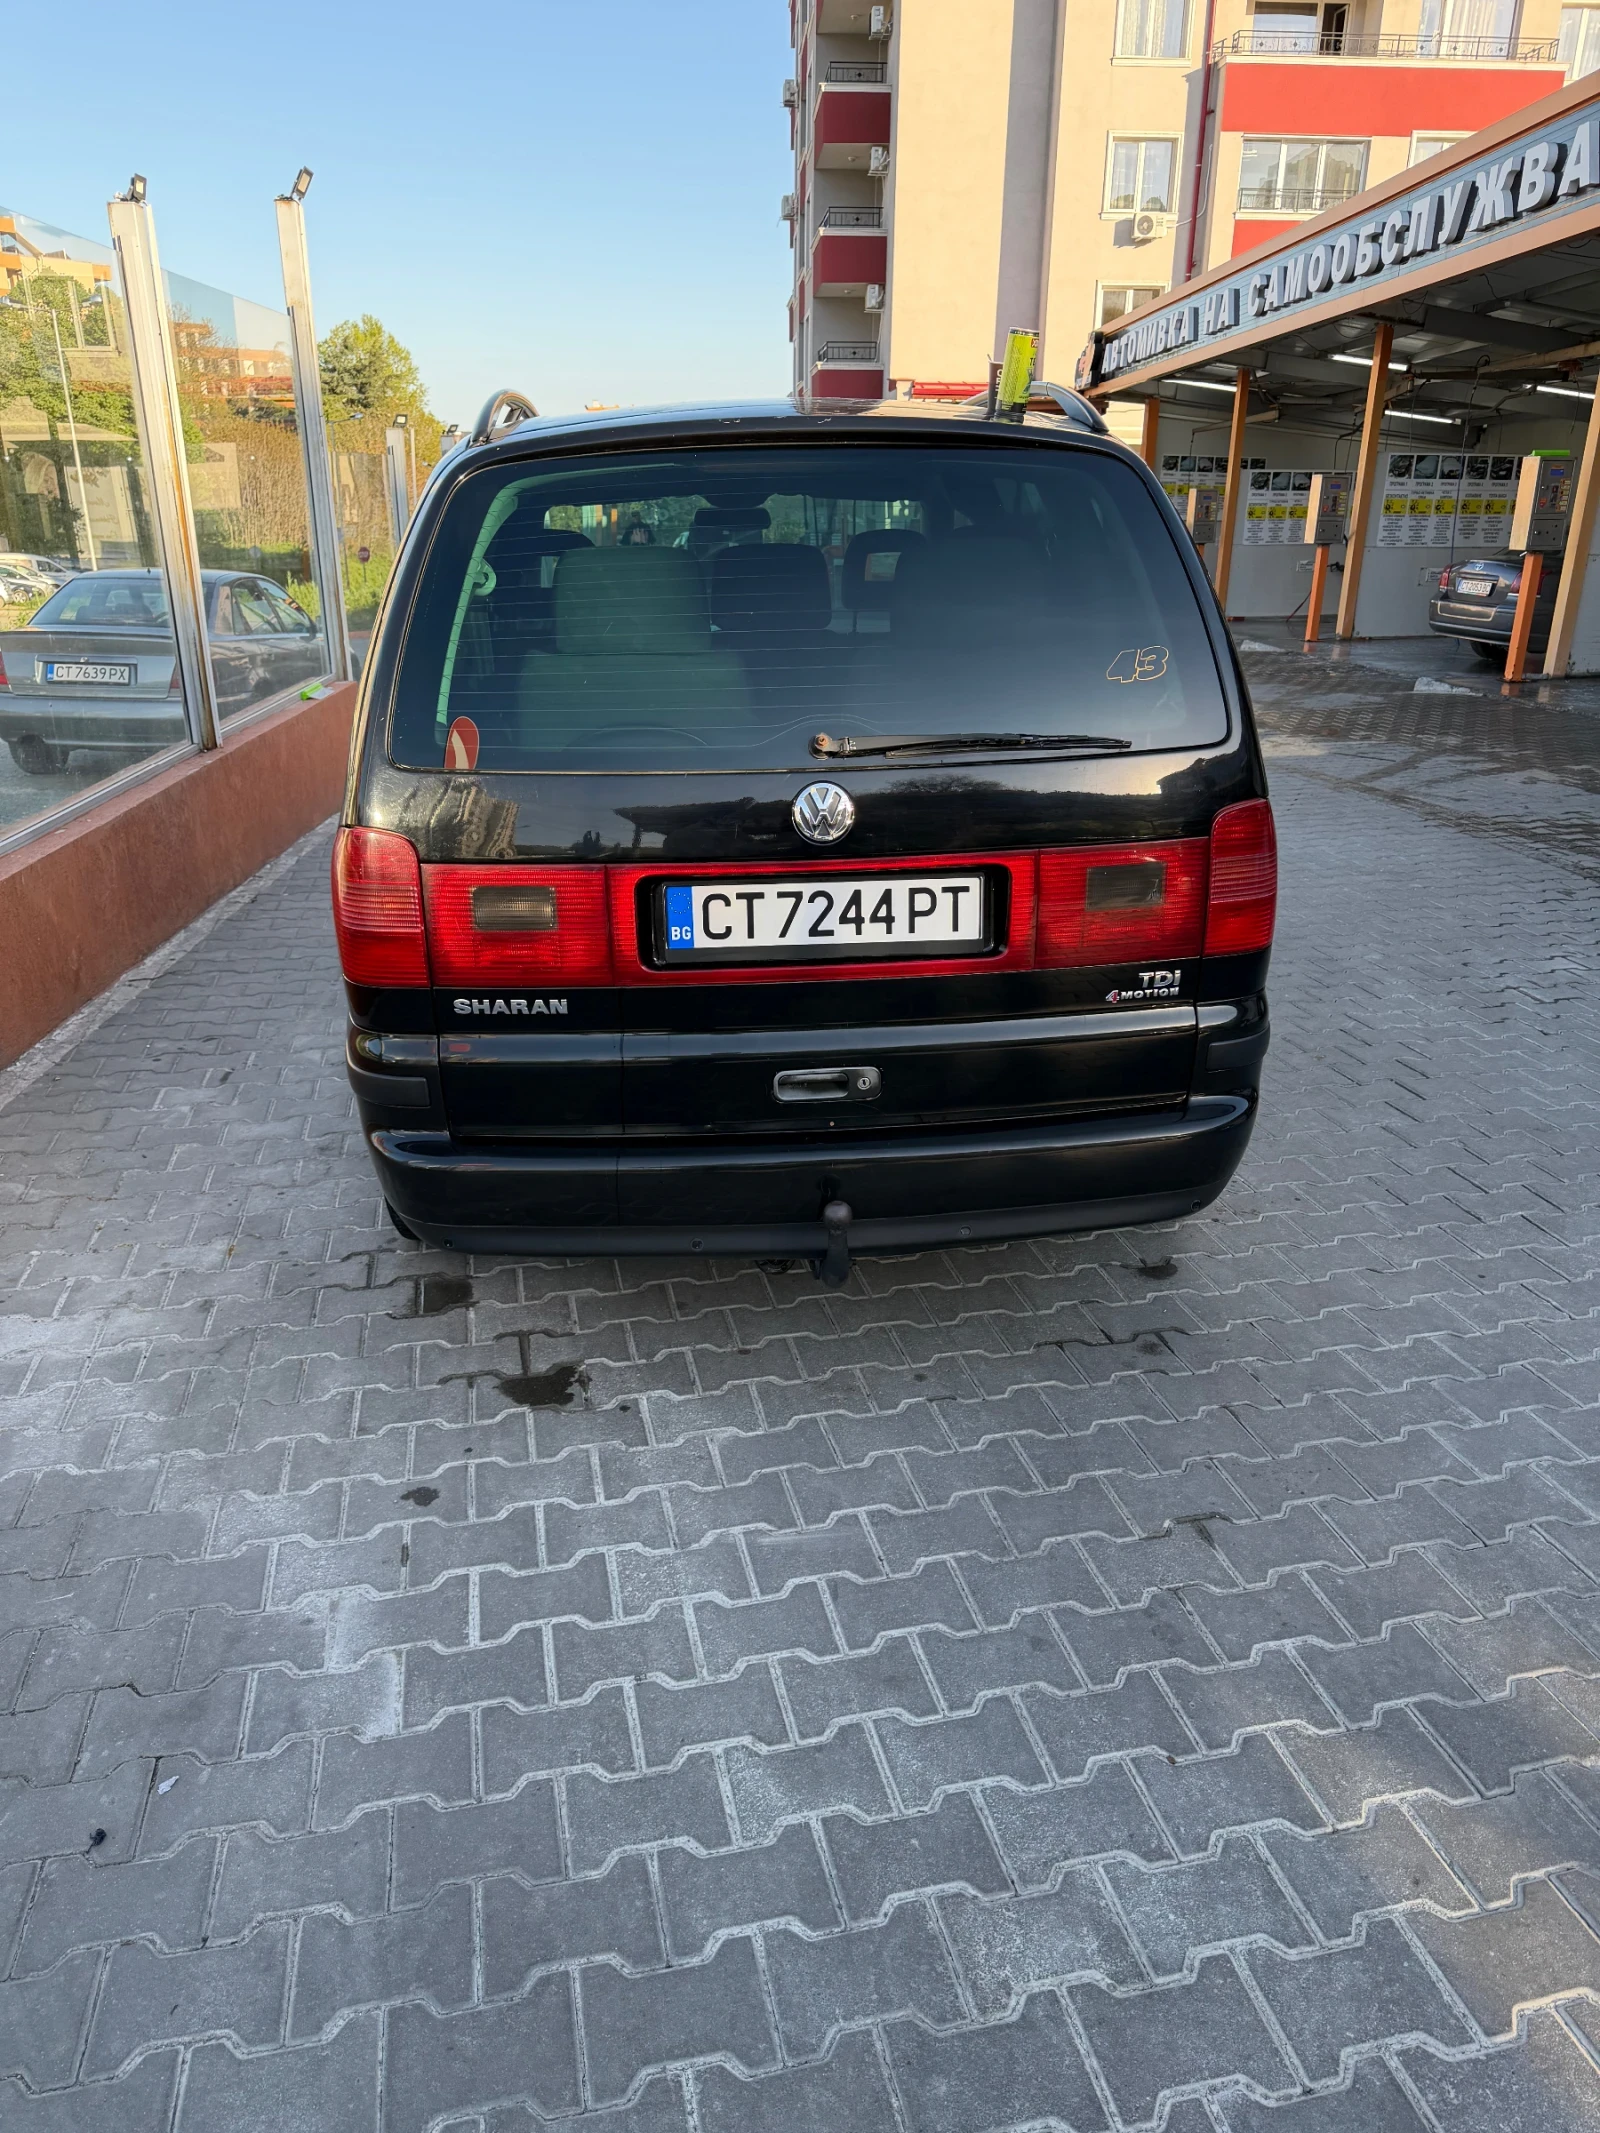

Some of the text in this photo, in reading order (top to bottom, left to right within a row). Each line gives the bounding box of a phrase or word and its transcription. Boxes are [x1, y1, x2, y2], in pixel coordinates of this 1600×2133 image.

[1101, 120, 1600, 375] АВТОМИВКА НА САМООБСЛУЖВА
[56, 666, 72, 678] CT
[76, 666, 106, 680] 7639
[109, 668, 126, 680] PX
[1106, 645, 1169, 683] 43
[702, 886, 970, 940] CT 7244 PT
[670, 926, 692, 941] BG
[1105, 986, 1180, 1004] 4MOTION
[453, 998, 568, 1014] SHARAN
